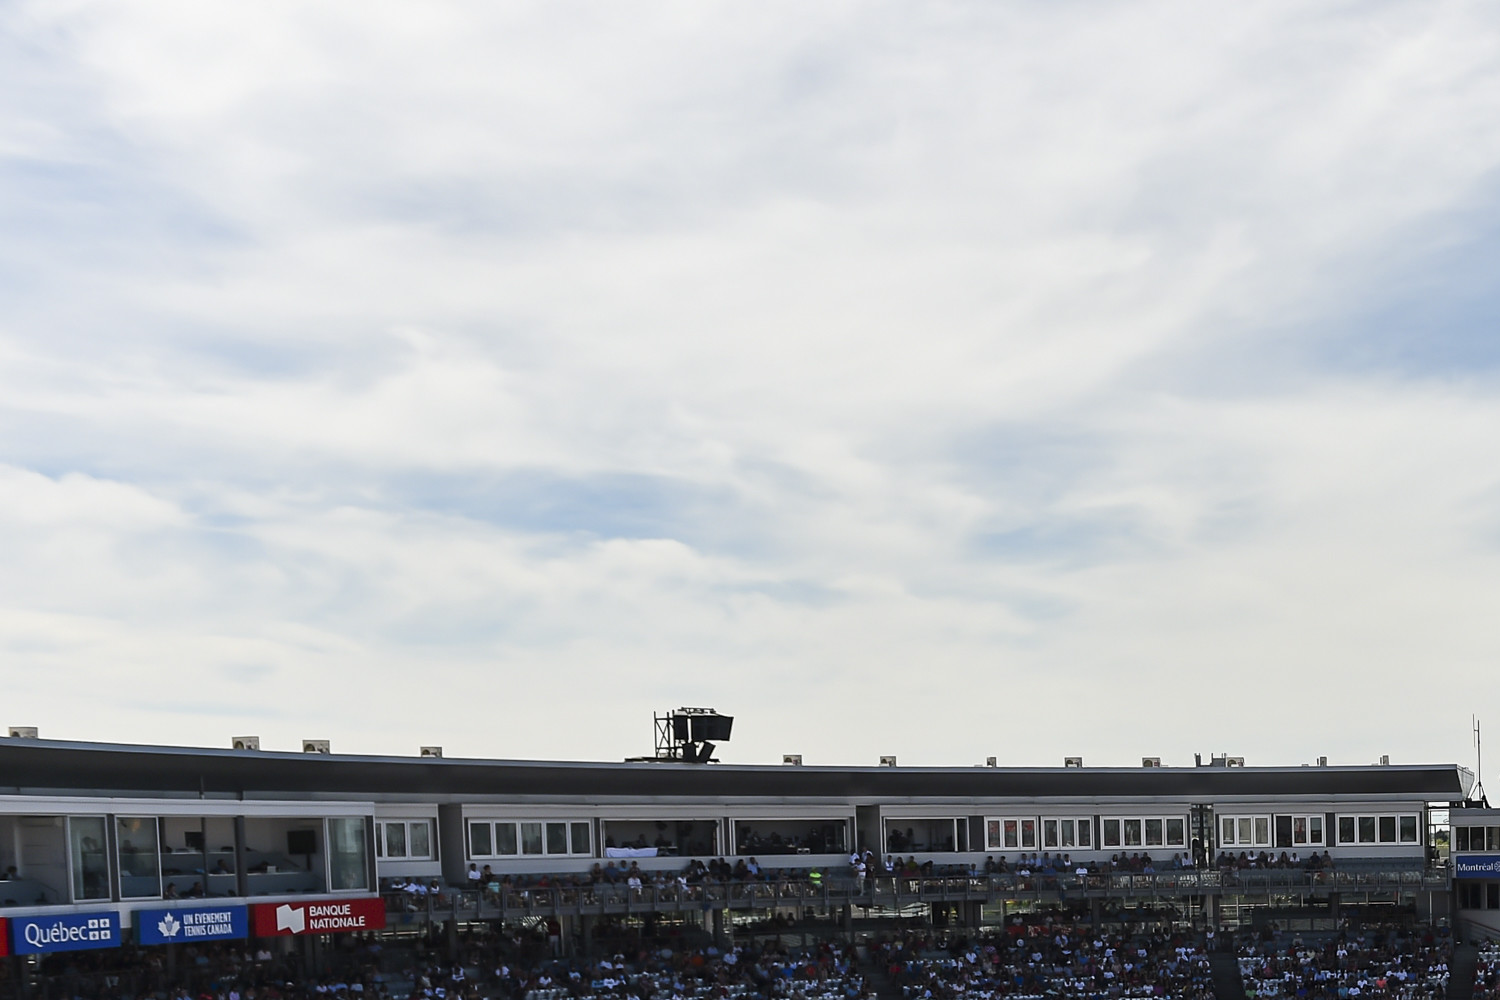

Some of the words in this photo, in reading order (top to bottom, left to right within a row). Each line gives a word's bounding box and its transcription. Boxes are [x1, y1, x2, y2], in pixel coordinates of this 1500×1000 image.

[1457, 861, 1494, 872] Montréal
[309, 904, 351, 917] BANQUE
[183, 913, 194, 925] UN
[309, 915, 366, 930] NATIONALE
[24, 921, 88, 947] Québec
[184, 924, 207, 937] TENNIS
[207, 923, 233, 936] CANADA
